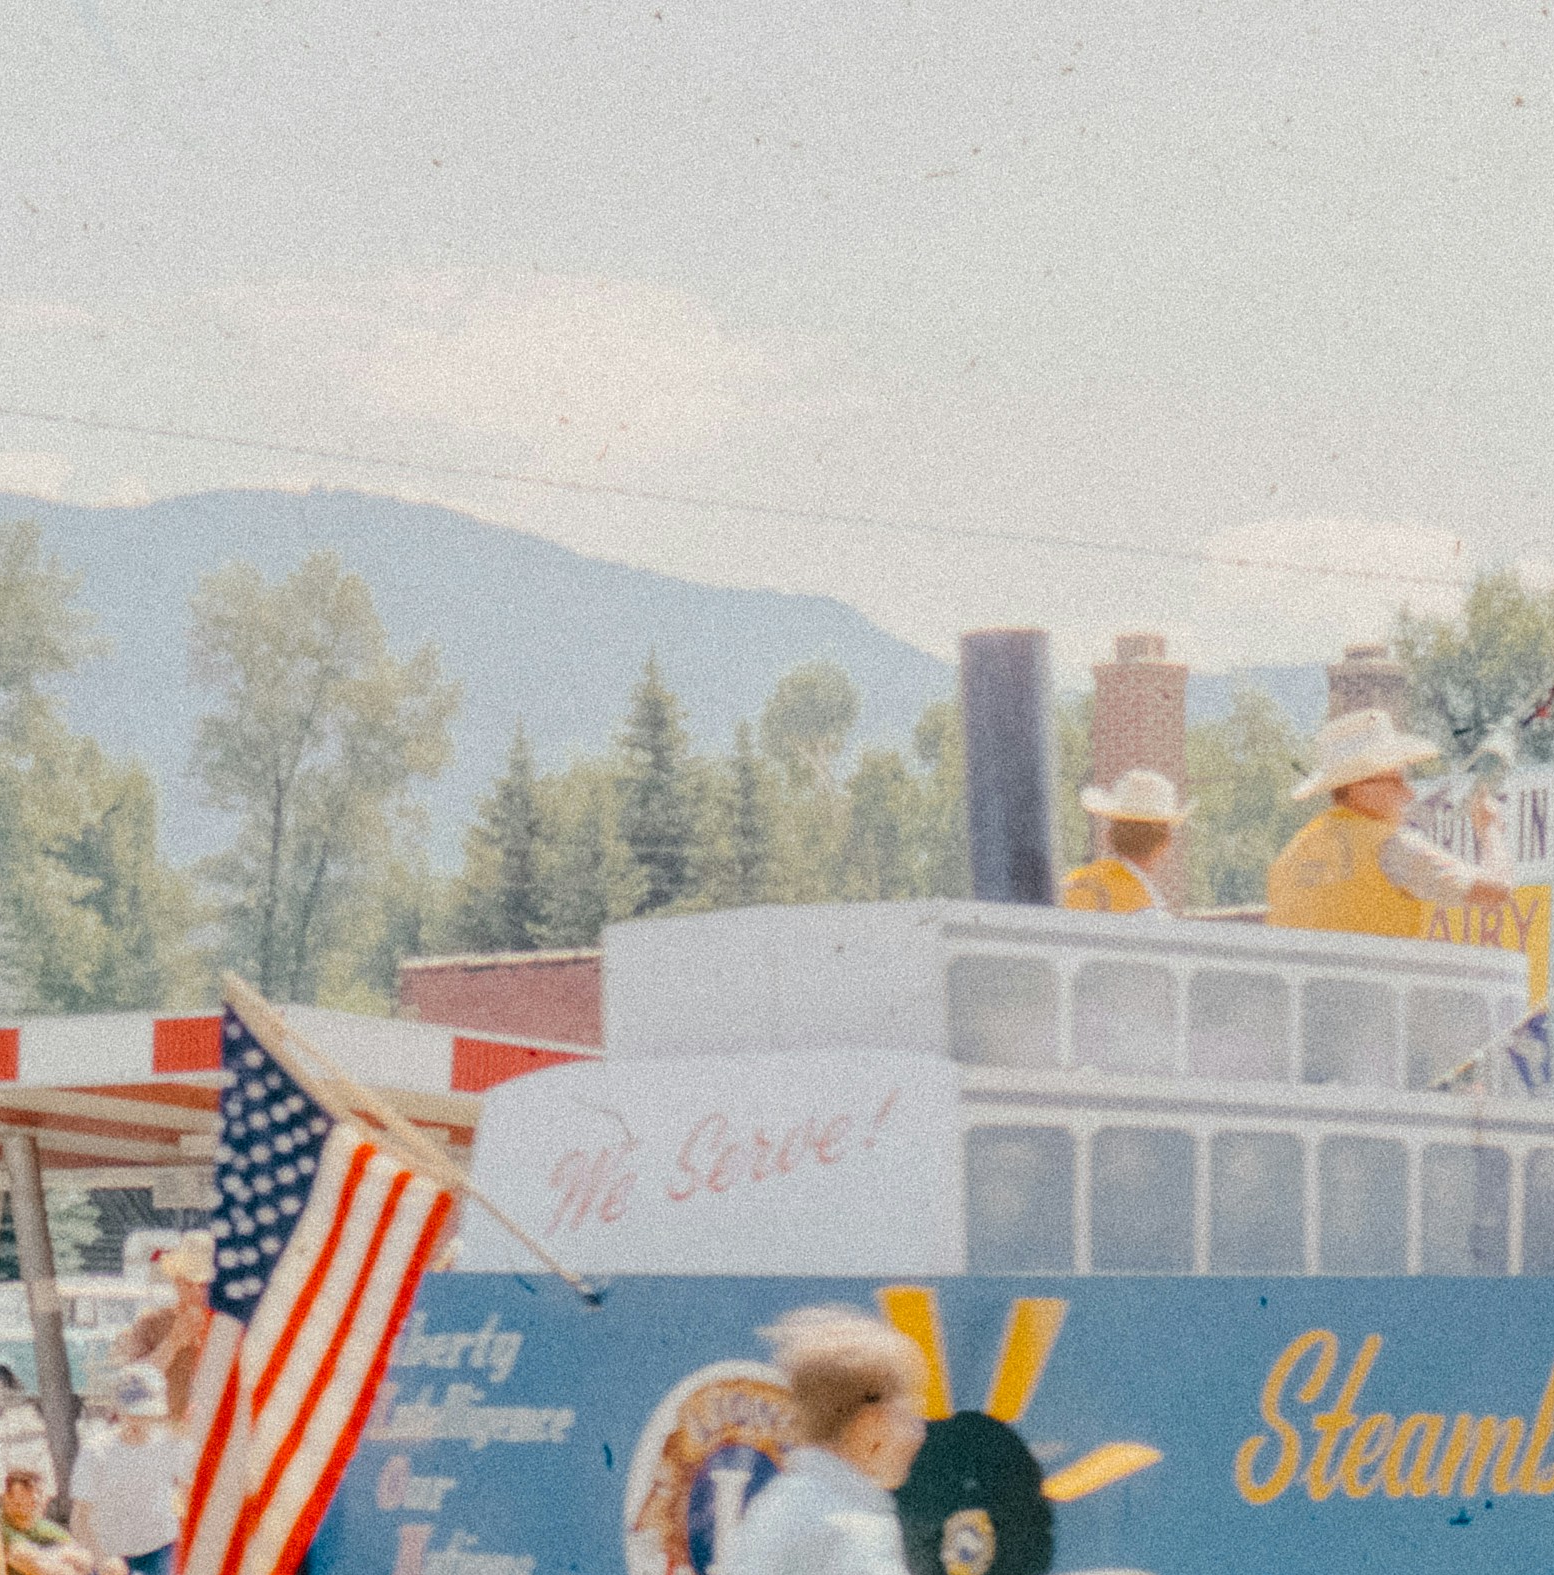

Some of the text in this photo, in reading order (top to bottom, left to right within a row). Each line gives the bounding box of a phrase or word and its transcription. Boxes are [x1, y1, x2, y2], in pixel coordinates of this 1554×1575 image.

[1426, 898, 1540, 954] AIRY
[547, 1089, 902, 1238] We Serve!
